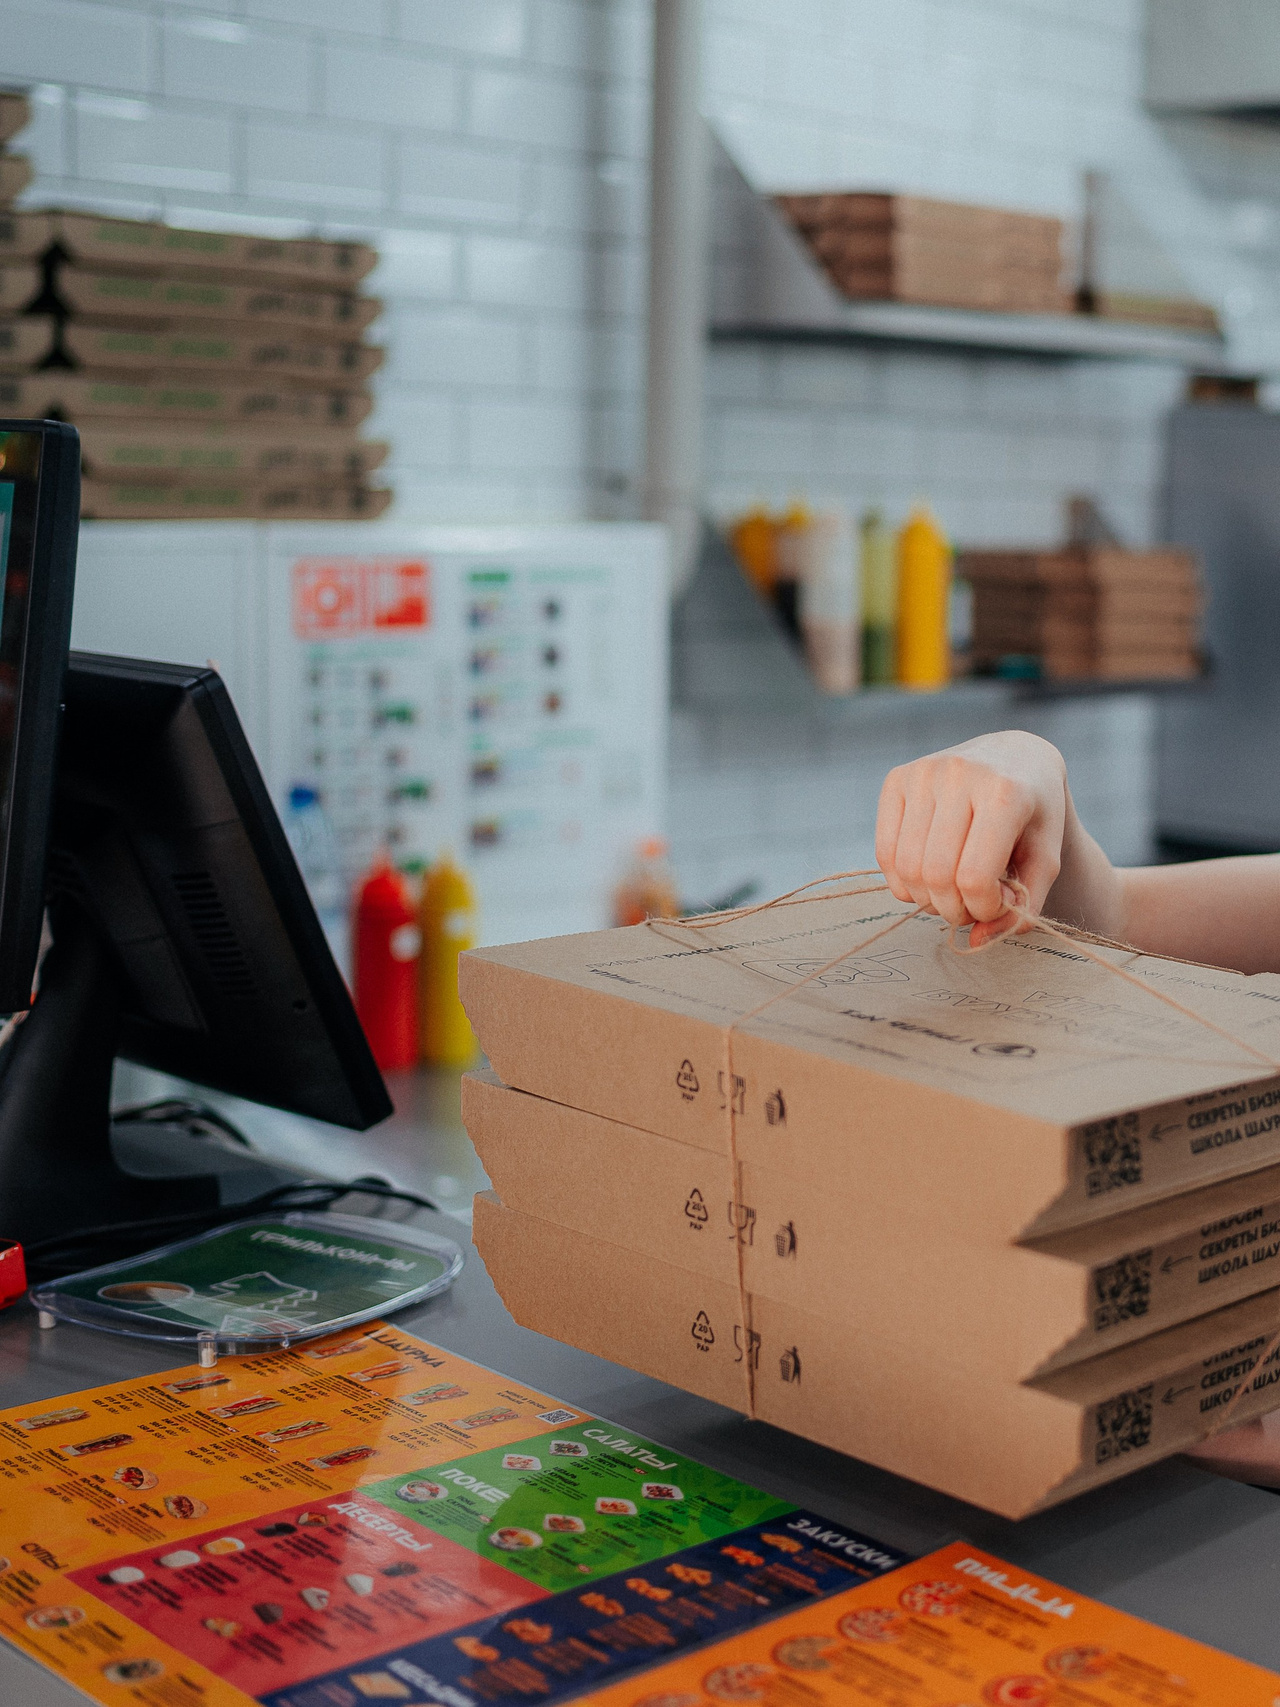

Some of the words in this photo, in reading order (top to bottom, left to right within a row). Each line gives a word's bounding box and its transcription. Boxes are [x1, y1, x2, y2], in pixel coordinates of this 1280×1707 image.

[1187, 1099, 1247, 1130] СЕКРЕТЫ
[1190, 1128, 1242, 1154] ШКОЛА
[1199, 1226, 1258, 1260] СЕКРЕТЫ
[1198, 1254, 1249, 1283] ШКОЛА
[698, 1324, 708, 1333] 20
[362, 1328, 446, 1368] ШАУРМА
[696, 1343, 710, 1352] PAP
[580, 1427, 681, 1472] САЛАТЫ
[438, 1468, 511, 1503] ПОКЕ
[326, 1498, 435, 1552] ДЕСЕРТЫ
[20, 1542, 69, 1571] СУПЫ
[785, 1517, 899, 1571] ЗАКУСКИ
[951, 1555, 1076, 1621] ПИЦЦА
